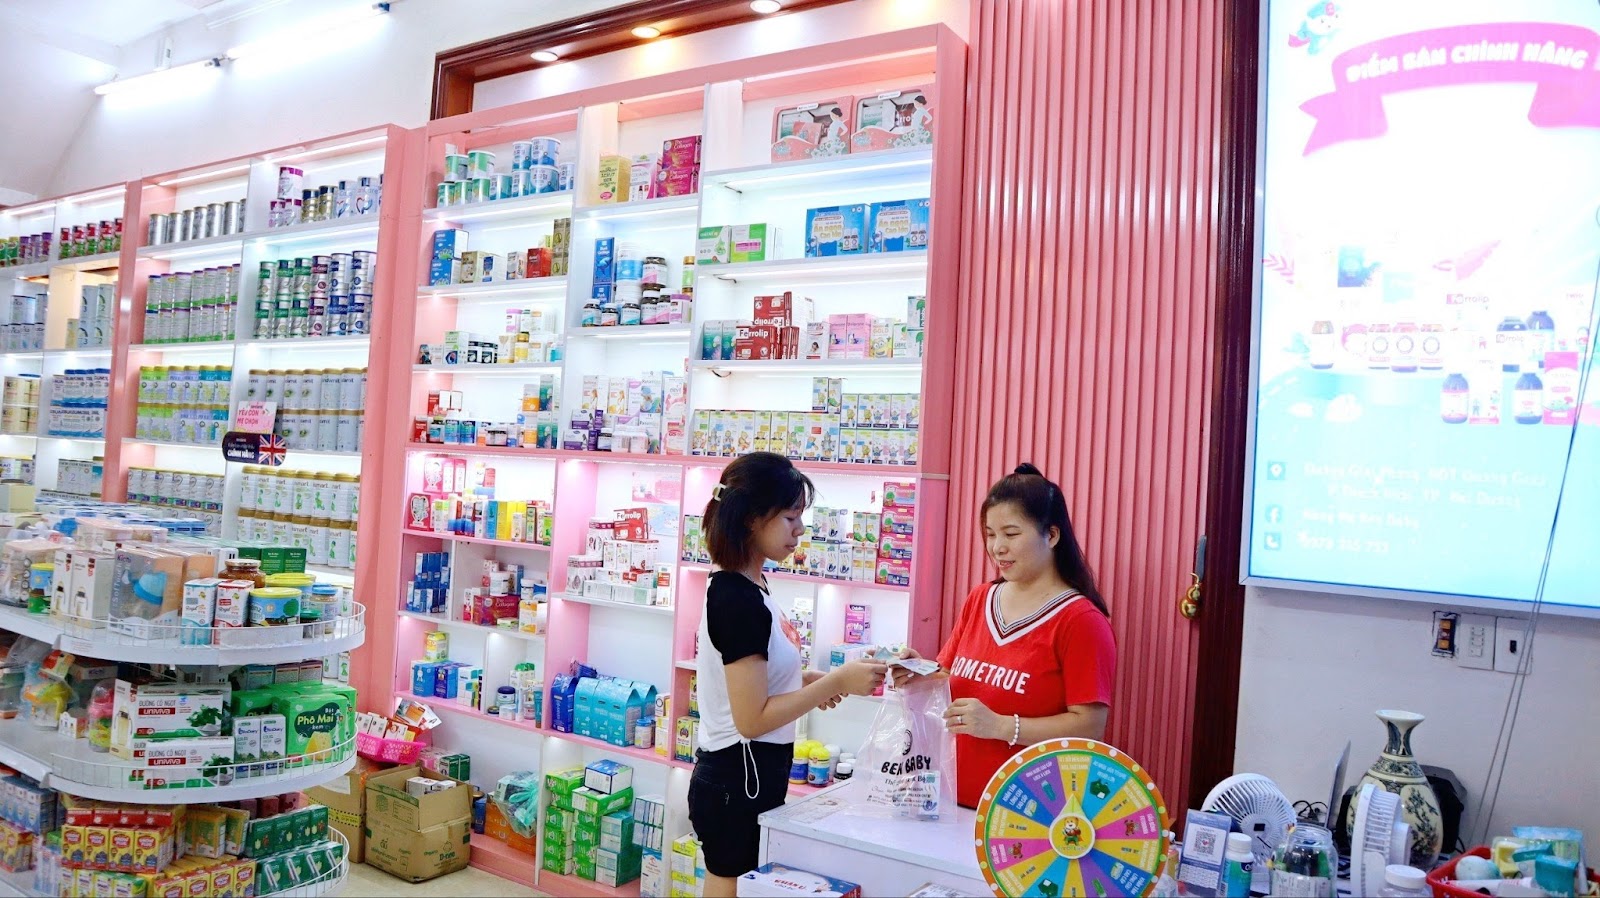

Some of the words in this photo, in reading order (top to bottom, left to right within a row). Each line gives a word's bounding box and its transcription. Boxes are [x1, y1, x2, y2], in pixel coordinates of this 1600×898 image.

[740, 329, 769, 338] Ferrolip
[616, 511, 641, 520] Ferrolip
[297, 715, 315, 725] Phô
[317, 714, 334, 723] Mai
[905, 755, 931, 773] BABY
